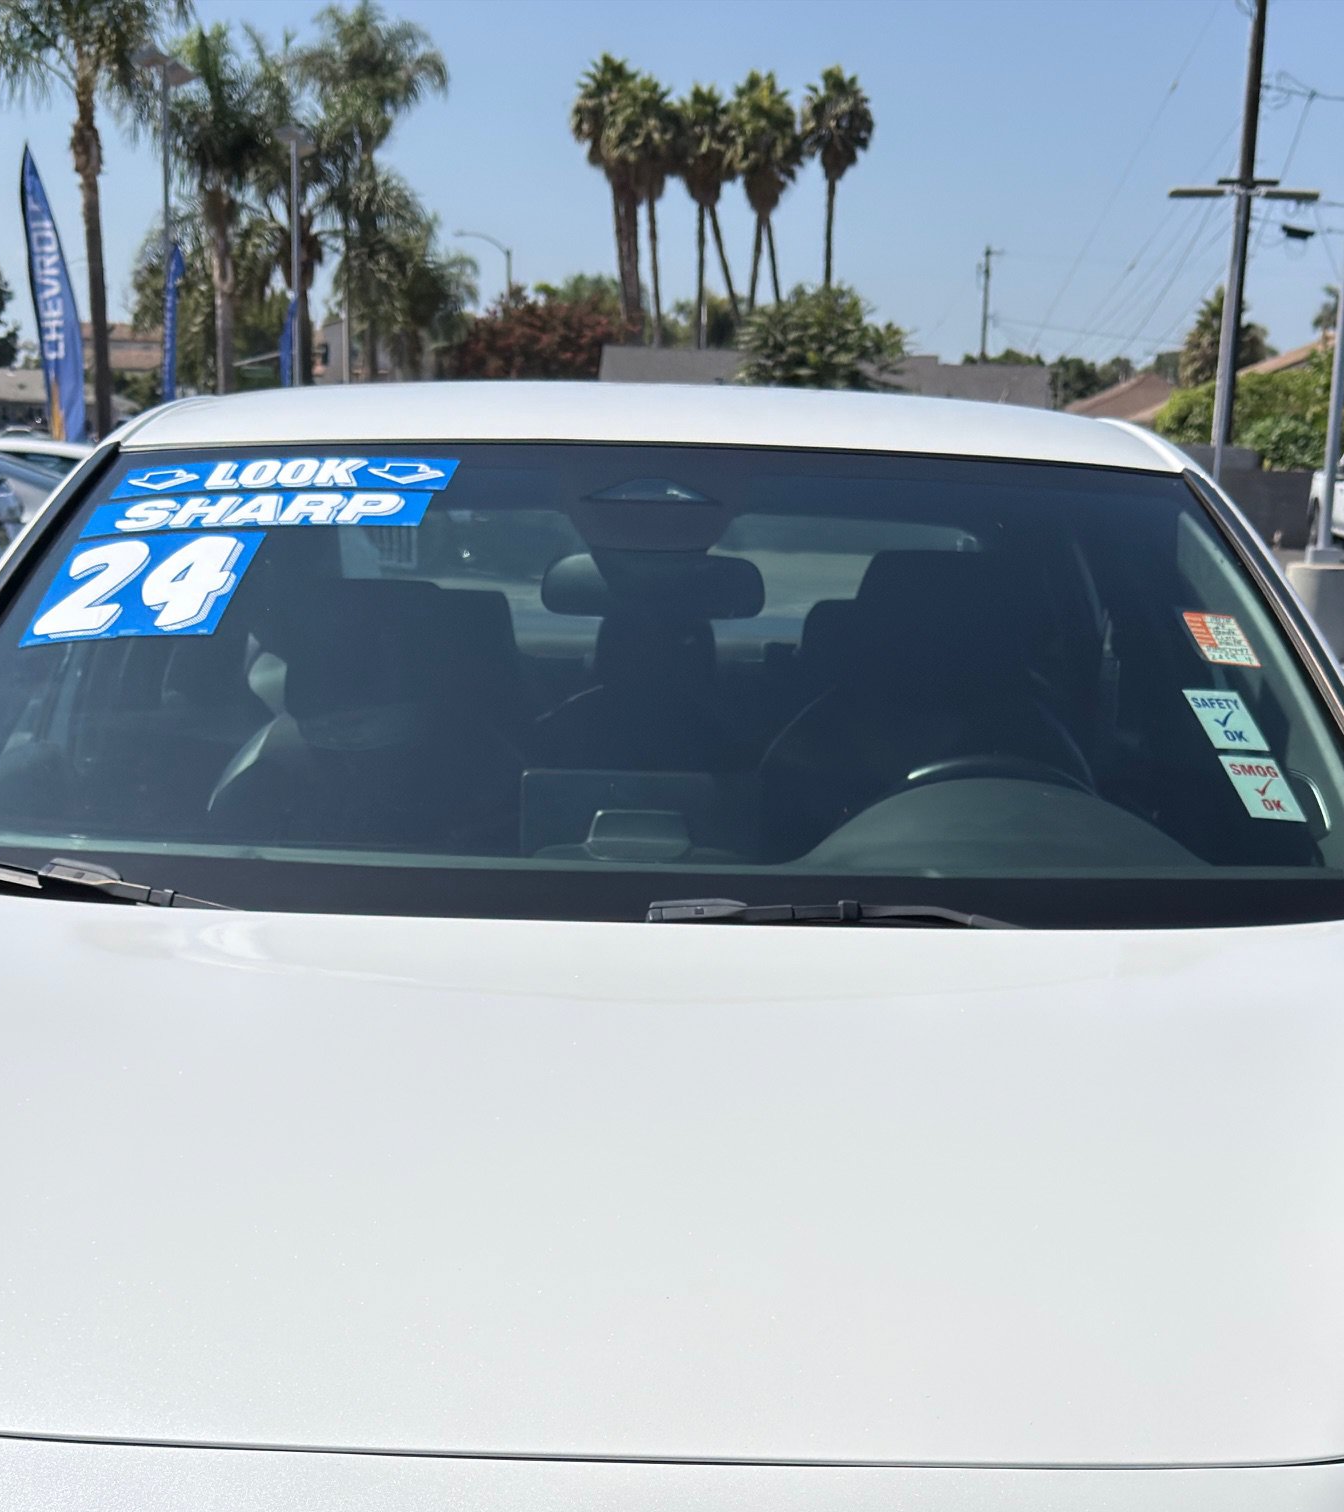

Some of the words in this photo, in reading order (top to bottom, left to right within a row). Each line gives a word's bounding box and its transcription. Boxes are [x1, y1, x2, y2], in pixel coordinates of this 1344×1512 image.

[31, 205, 65, 360] CHEVROL
[204, 459, 369, 489] LOOK
[114, 493, 406, 531] SHARP
[33, 536, 245, 639] 24
[1192, 697, 1240, 709] SAFETY
[1225, 730, 1248, 742] OK
[1229, 763, 1279, 778] SMOG
[1262, 799, 1286, 811] OK
